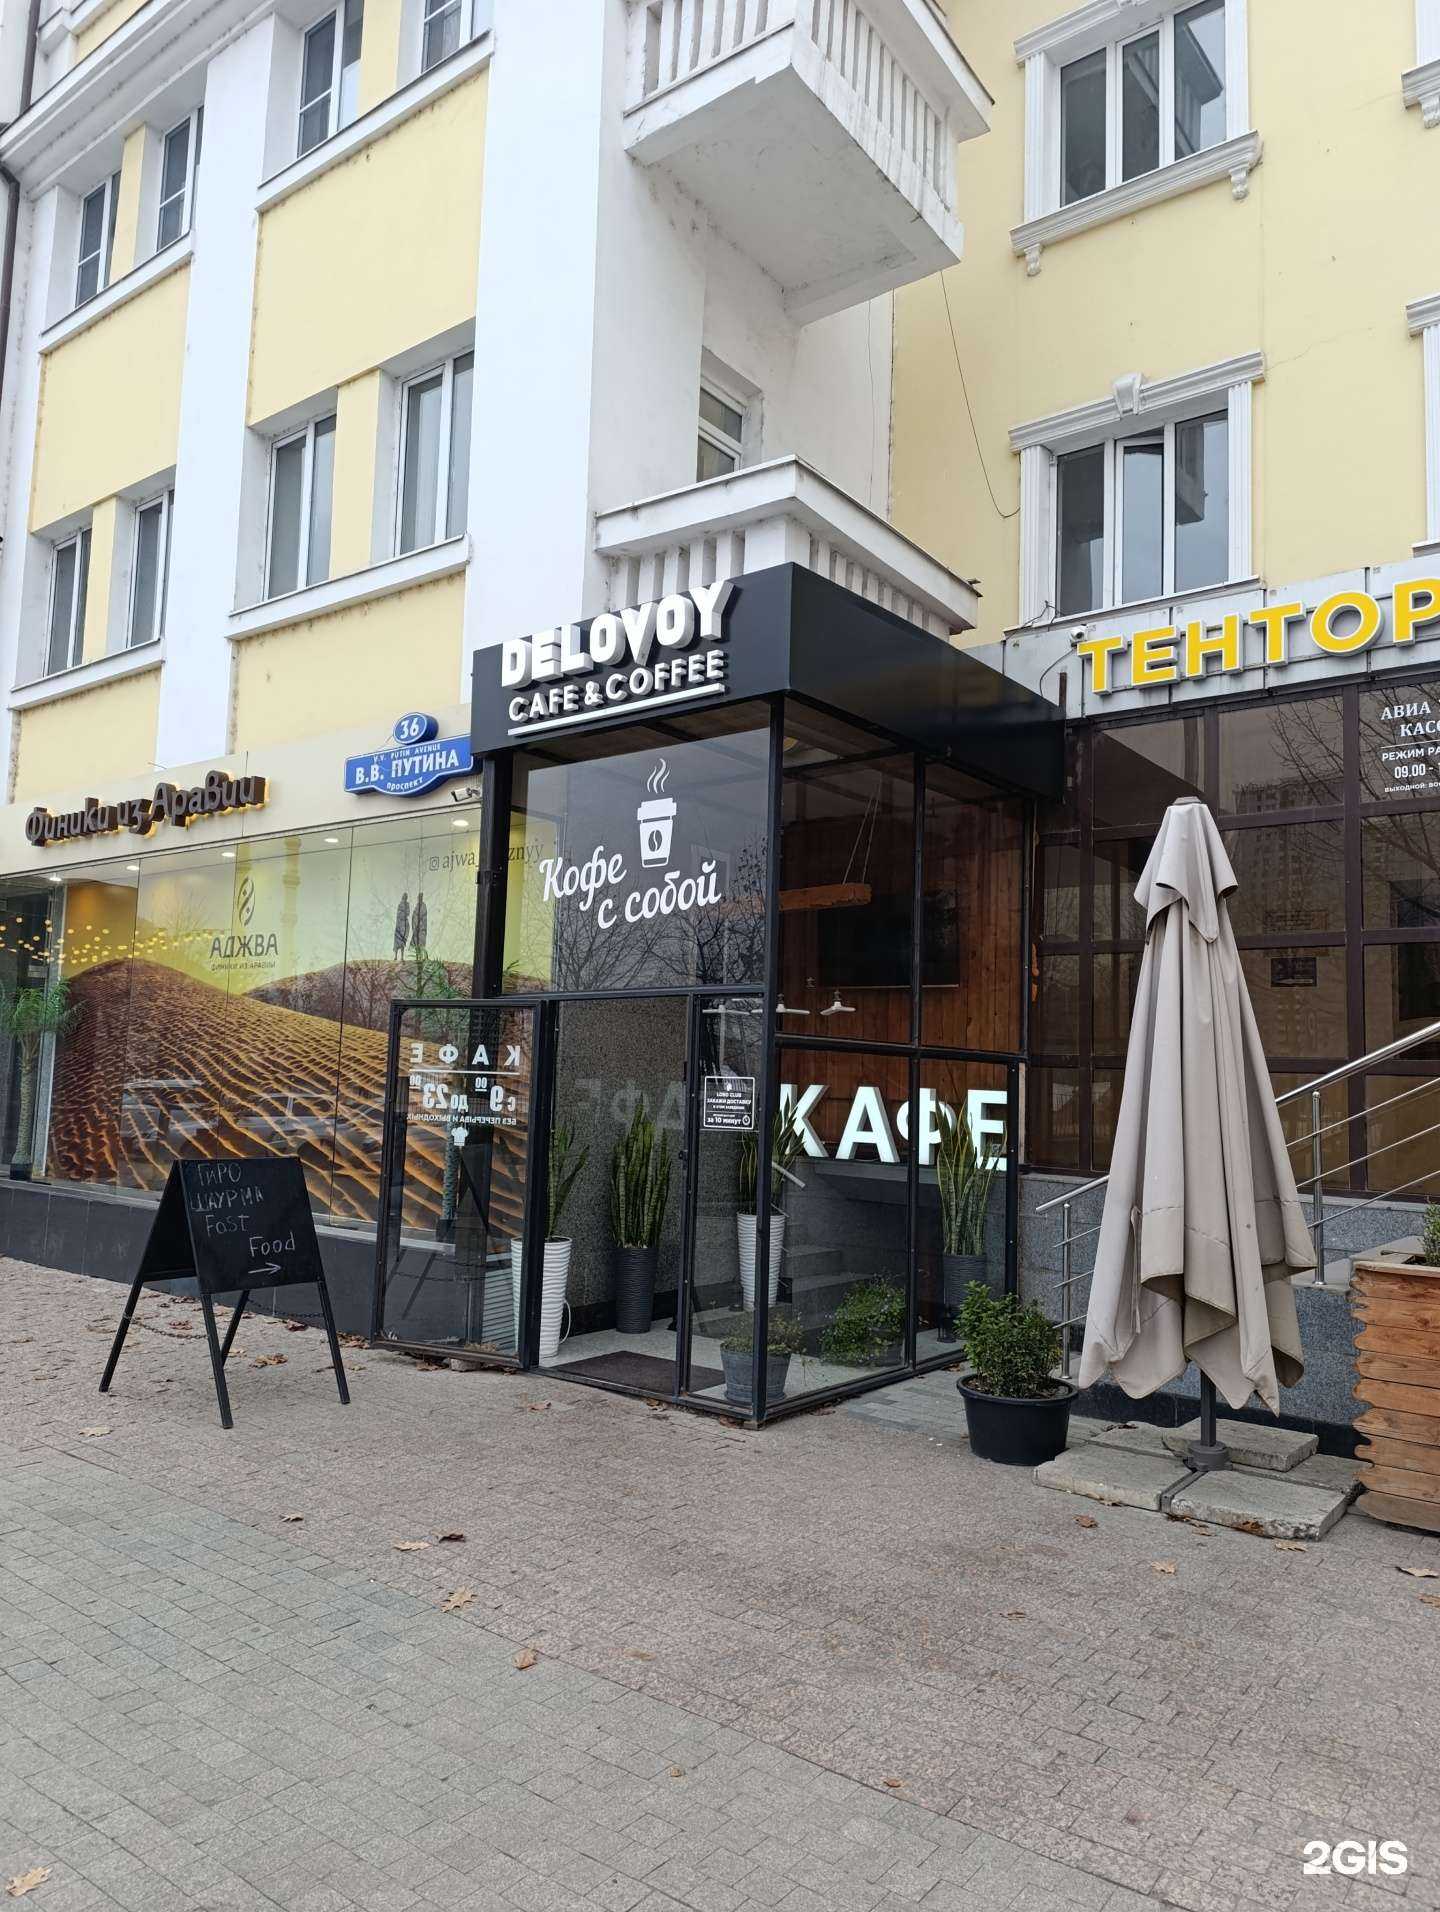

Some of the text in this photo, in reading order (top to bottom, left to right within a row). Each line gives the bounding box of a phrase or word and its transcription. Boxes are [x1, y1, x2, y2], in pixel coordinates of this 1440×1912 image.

[502, 580, 735, 689] DELOVOY
[1077, 577, 1440, 695] ТЕНТОР
[509, 684, 580, 722] CAFE
[605, 650, 725, 700] COFFEE
[1381, 701, 1431, 720] АВИА
[400, 717, 420, 740] 36
[355, 749, 459, 785] В.В. ПУТИНА
[391, 750, 410, 760] PUTIN
[415, 743, 441, 754] AVENUE
[1382, 748, 1424, 761] РЕЖИМ
[1394, 763, 1426, 779] 09.00
[25, 770, 266, 847] Финики из Аравии
[539, 845, 627, 911] Кофе
[597, 860, 721, 929] с собой
[209, 933, 279, 959] АДЖВА
[780, 1083, 1008, 1171] КАФЕ
[205, 1214, 250, 1237] Fast
[249, 1231, 296, 1257] Food
